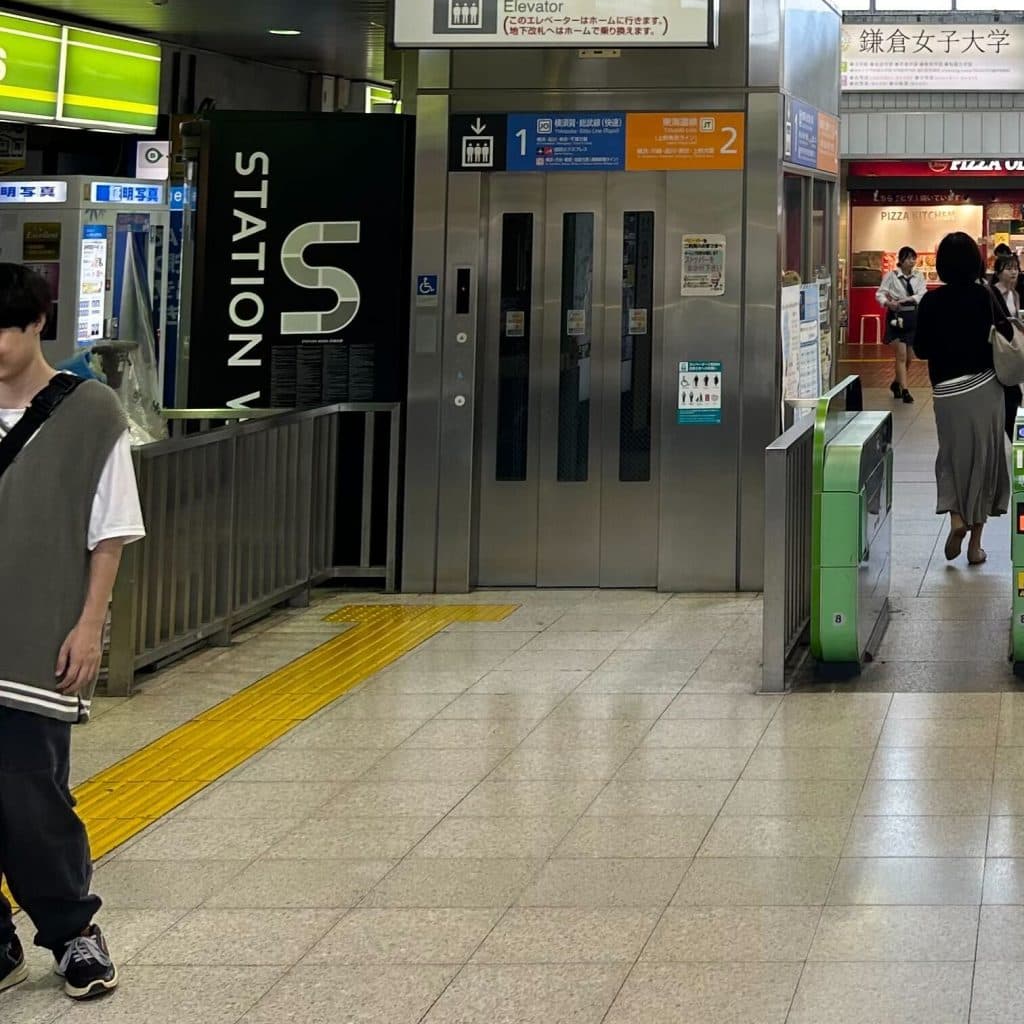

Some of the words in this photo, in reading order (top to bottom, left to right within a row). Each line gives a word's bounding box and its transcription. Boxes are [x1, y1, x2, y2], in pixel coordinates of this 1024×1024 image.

[504, 0, 564, 13] Elevator
[859, 28, 1010, 54] 鎌倉女子大学
[515, 128, 527, 156] 1
[720, 126, 737, 154] 2
[881, 211, 909, 221] PIZZA
[227, 151, 270, 367] STATION
[835, 614, 842, 624] 8
